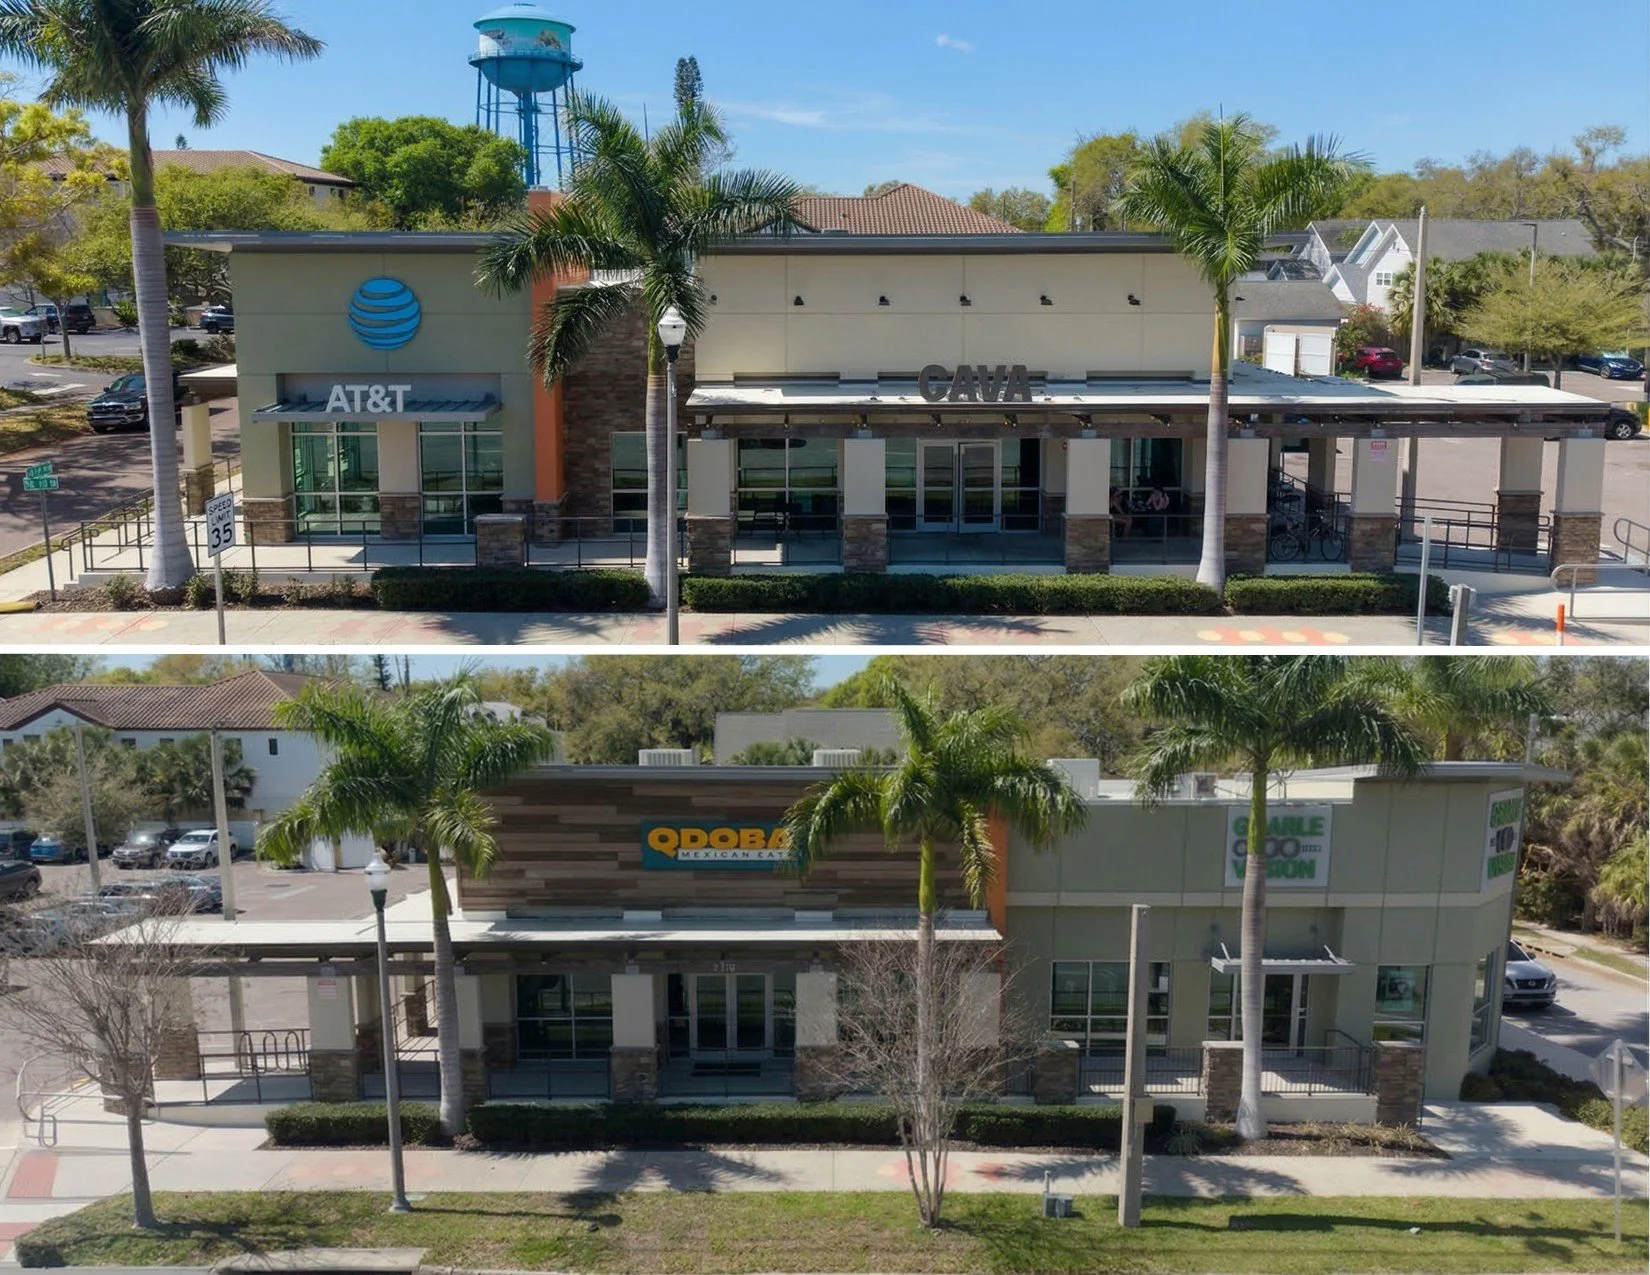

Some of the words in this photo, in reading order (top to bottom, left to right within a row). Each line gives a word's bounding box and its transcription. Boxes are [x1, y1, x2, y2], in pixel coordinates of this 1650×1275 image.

[918, 364, 1033, 402] CAVA
[325, 384, 412, 413] AT&T
[209, 498, 232, 515] SPEED
[212, 522, 232, 549] 35
[647, 827, 793, 858] QDOBA
[1231, 859, 1317, 879] VSION
